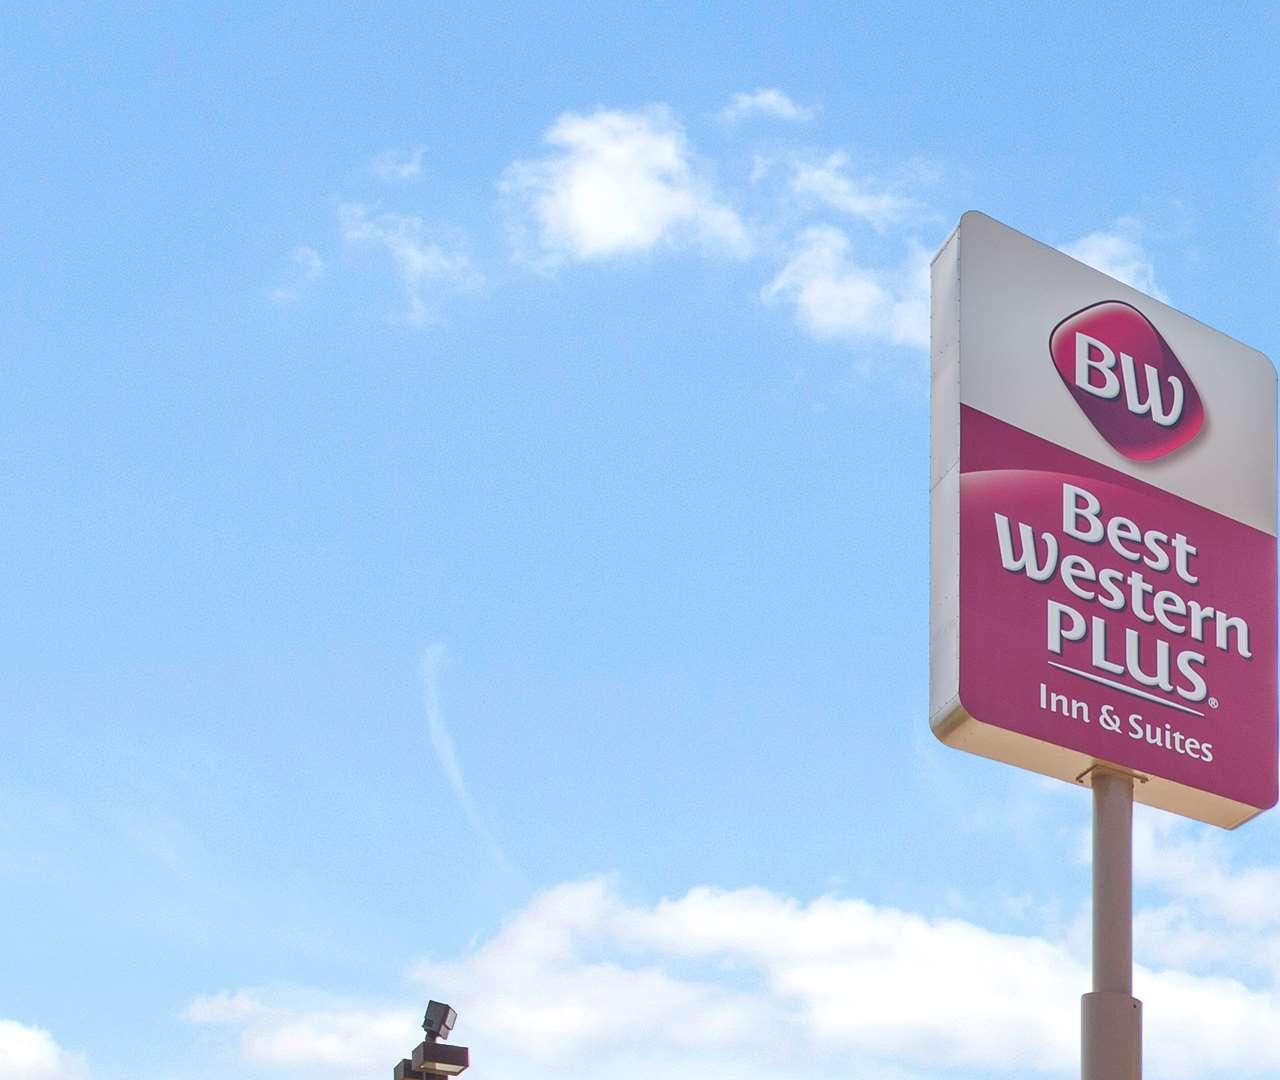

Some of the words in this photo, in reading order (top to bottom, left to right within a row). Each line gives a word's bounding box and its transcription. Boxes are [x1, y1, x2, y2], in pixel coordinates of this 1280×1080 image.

[1075, 332, 1184, 428] BW
[1063, 483, 1199, 585] Best
[995, 513, 1253, 659] Western
[1047, 600, 1208, 703] PLUS
[1040, 683, 1089, 724] Inn
[1100, 704, 1122, 733] &
[1128, 714, 1214, 763] Suites
